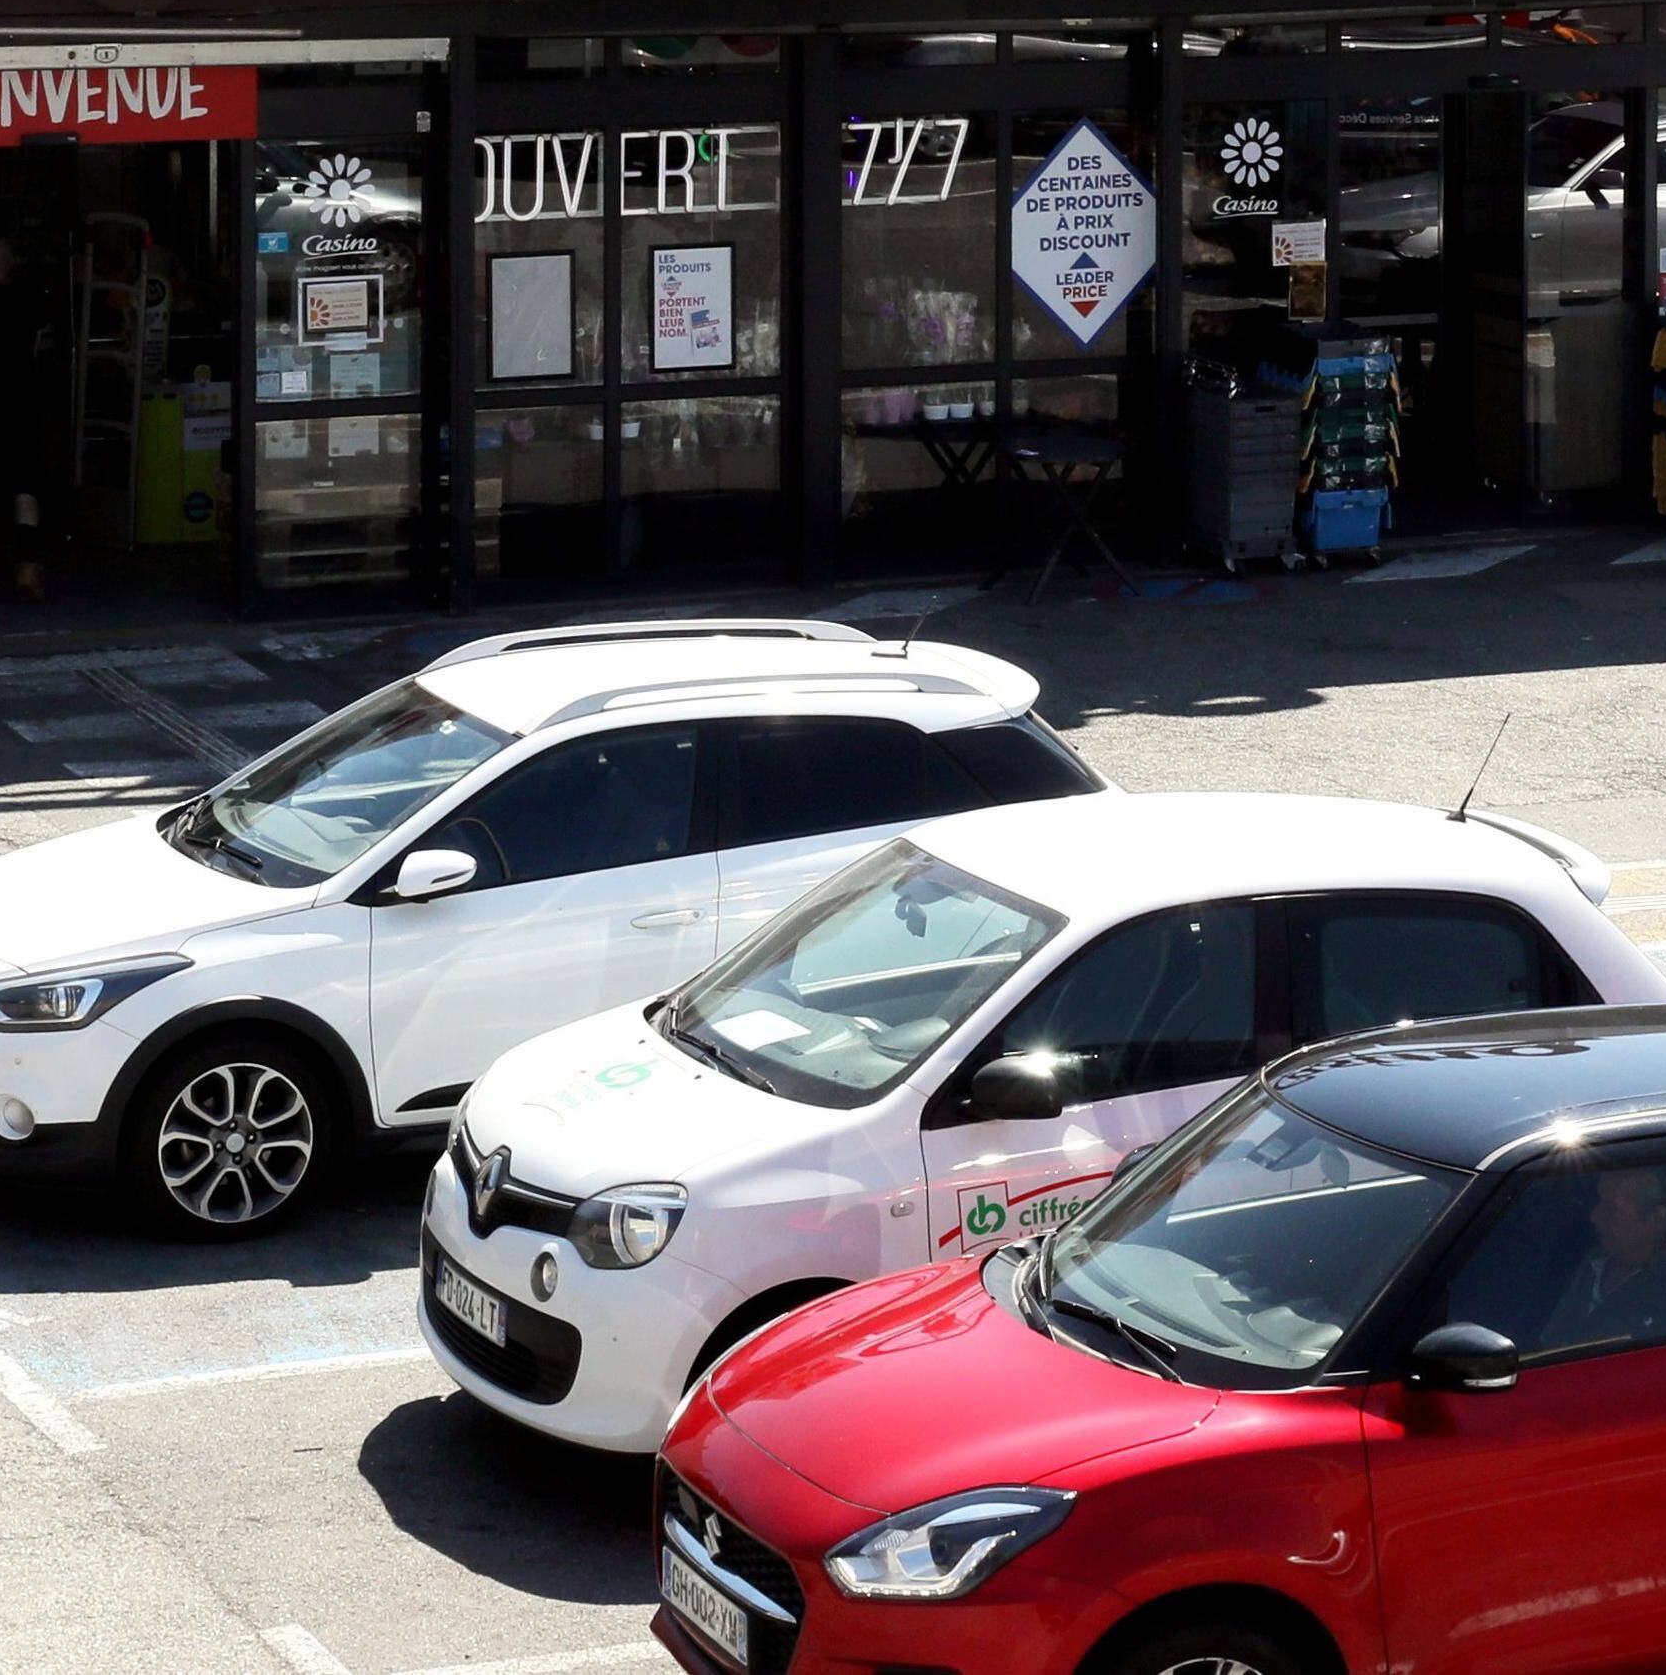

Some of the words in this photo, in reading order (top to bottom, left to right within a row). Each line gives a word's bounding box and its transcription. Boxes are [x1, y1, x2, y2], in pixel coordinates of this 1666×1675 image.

[1067, 156, 1101, 171] DES
[1038, 173, 1132, 193] CENTAINES
[1026, 198, 1051, 213] DE
[1055, 192, 1144, 211] PRODUITS
[1212, 195, 1279, 216] Casino
[1056, 213, 1070, 231] À
[1074, 214, 1114, 230] PRIX
[301, 233, 379, 257] Casino
[1040, 233, 1132, 252] DISCOUNT
[658, 254, 676, 264] LES
[658, 263, 712, 274] PRODUITS
[1056, 271, 1115, 286] LEADER
[1062, 285, 1108, 300] PRICE
[659, 297, 706, 308] PORTENT
[659, 308, 683, 318] BIEN
[659, 318, 686, 328] LEUR
